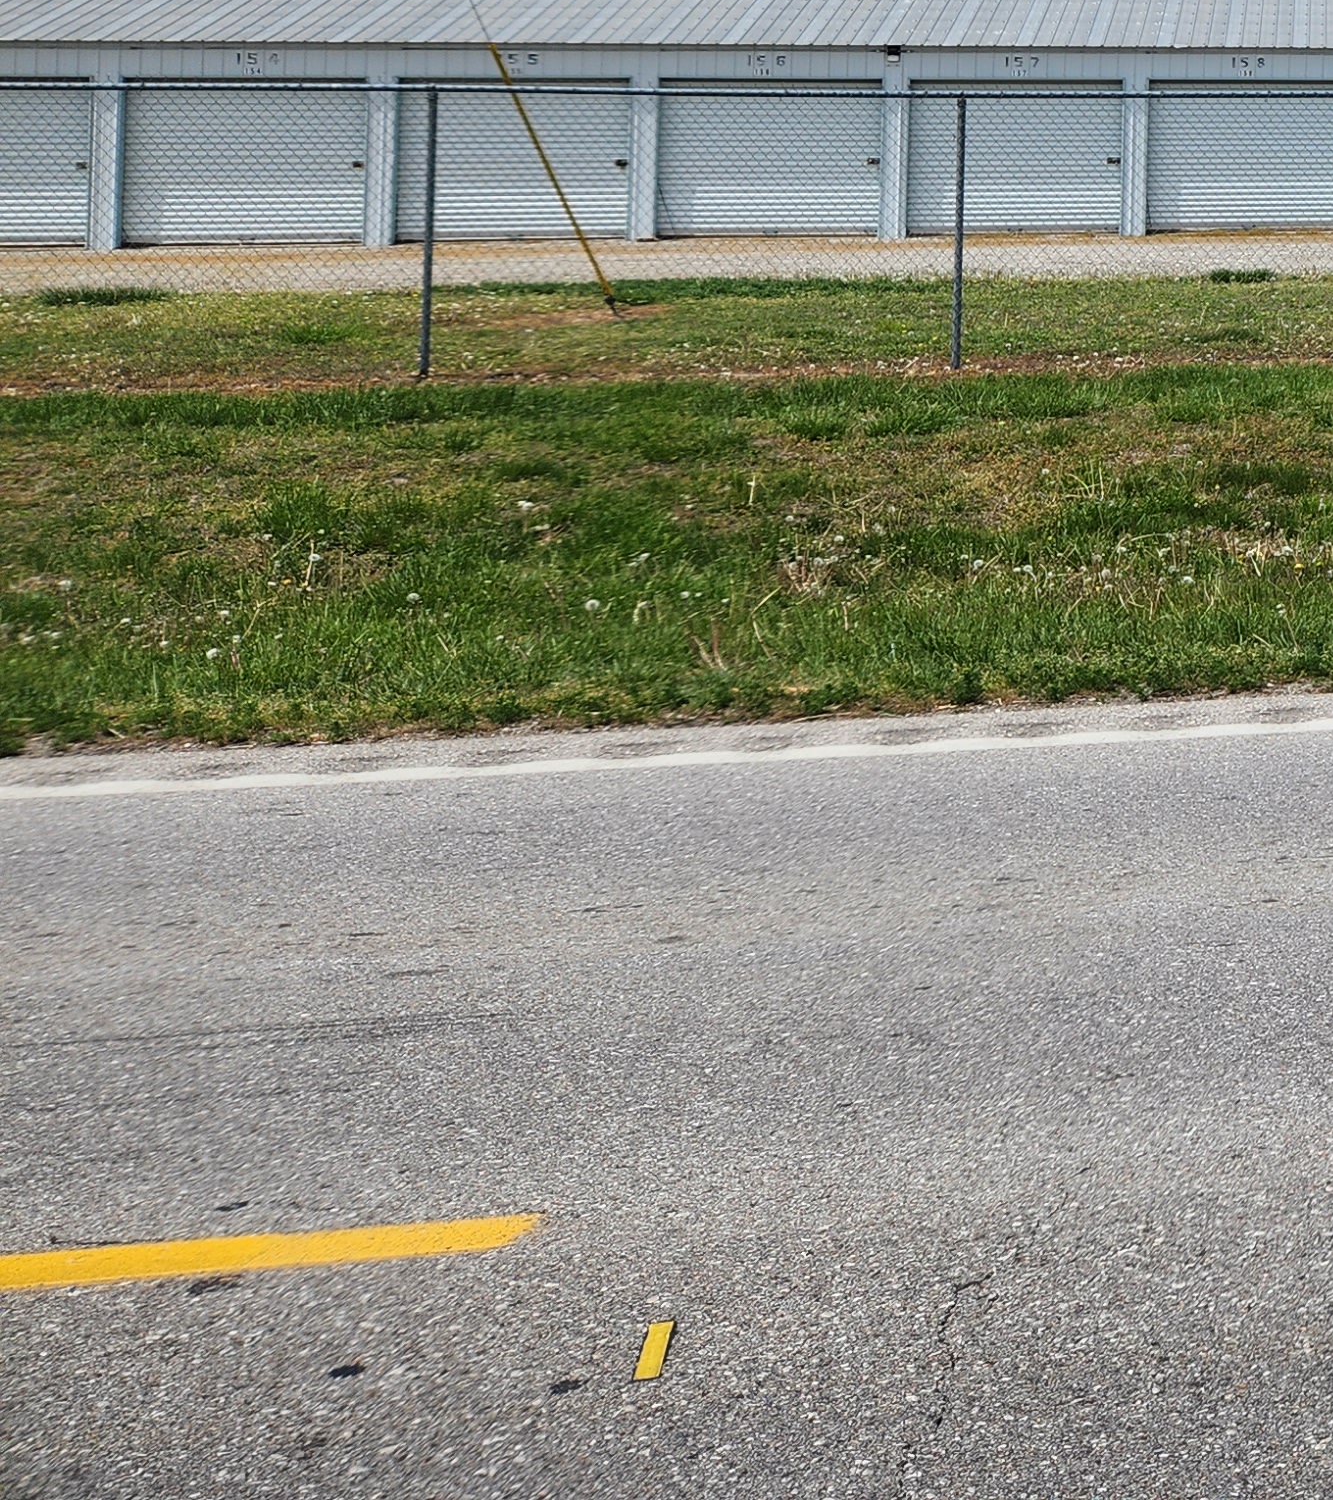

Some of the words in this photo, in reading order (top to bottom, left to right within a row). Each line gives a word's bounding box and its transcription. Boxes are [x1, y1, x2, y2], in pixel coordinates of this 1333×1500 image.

[237, 53, 280, 65] 154
[748, 55, 786, 67] 156
[1006, 57, 1040, 68] 157
[1232, 57, 1266, 68] 158
